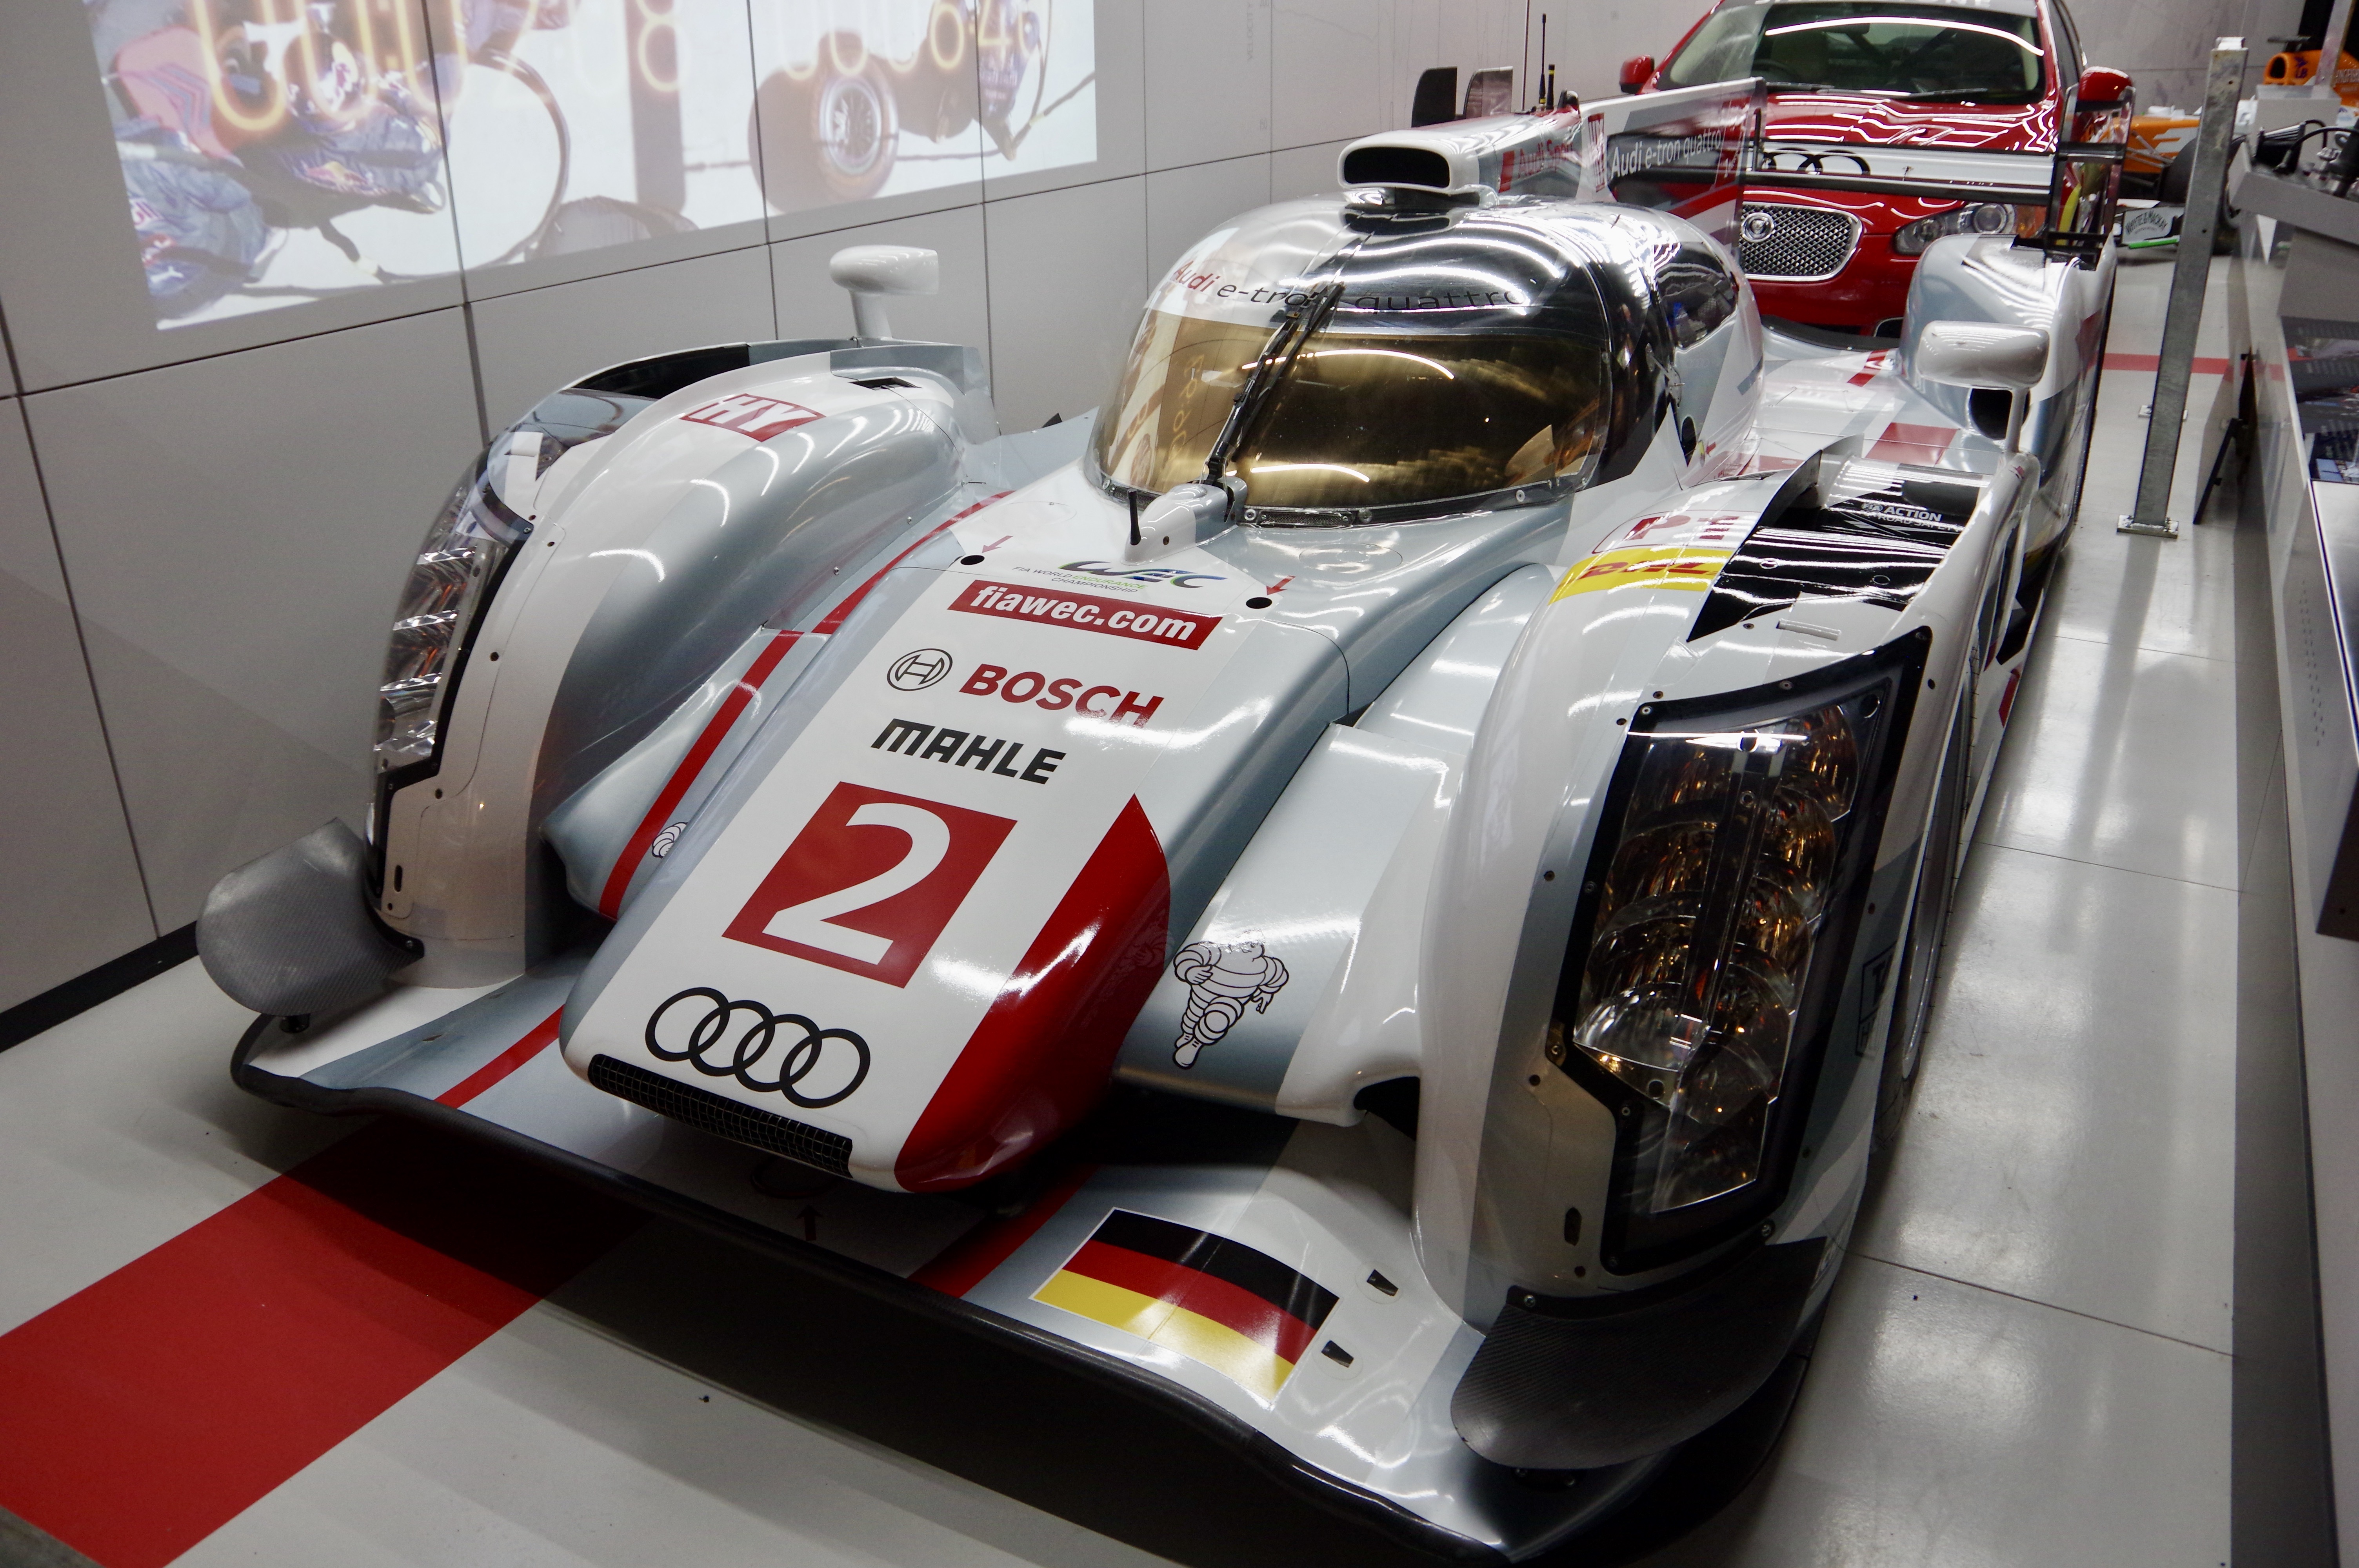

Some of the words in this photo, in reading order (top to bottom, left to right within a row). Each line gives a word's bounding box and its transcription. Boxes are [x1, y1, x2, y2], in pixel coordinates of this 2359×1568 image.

[1518, 142, 1545, 179] Audi
[1610, 141, 1643, 180] Audi
[1645, 140, 1681, 170] e-tron
[1683, 128, 1721, 164] quattro
[1170, 260, 1221, 292] Audi
[1355, 290, 1527, 314] quattro
[1884, 506, 1942, 522] ACTION
[1032, 569, 1072, 578] WORLD
[1072, 575, 1149, 590] ENDURANCE
[1051, 577, 1138, 593] CHAMPIONSHIP
[971, 585, 1197, 641] fiawec.com
[959, 663, 1165, 728] BOSCH
[870, 718, 1067, 784] MAHLE
[762, 801, 951, 965] 2
